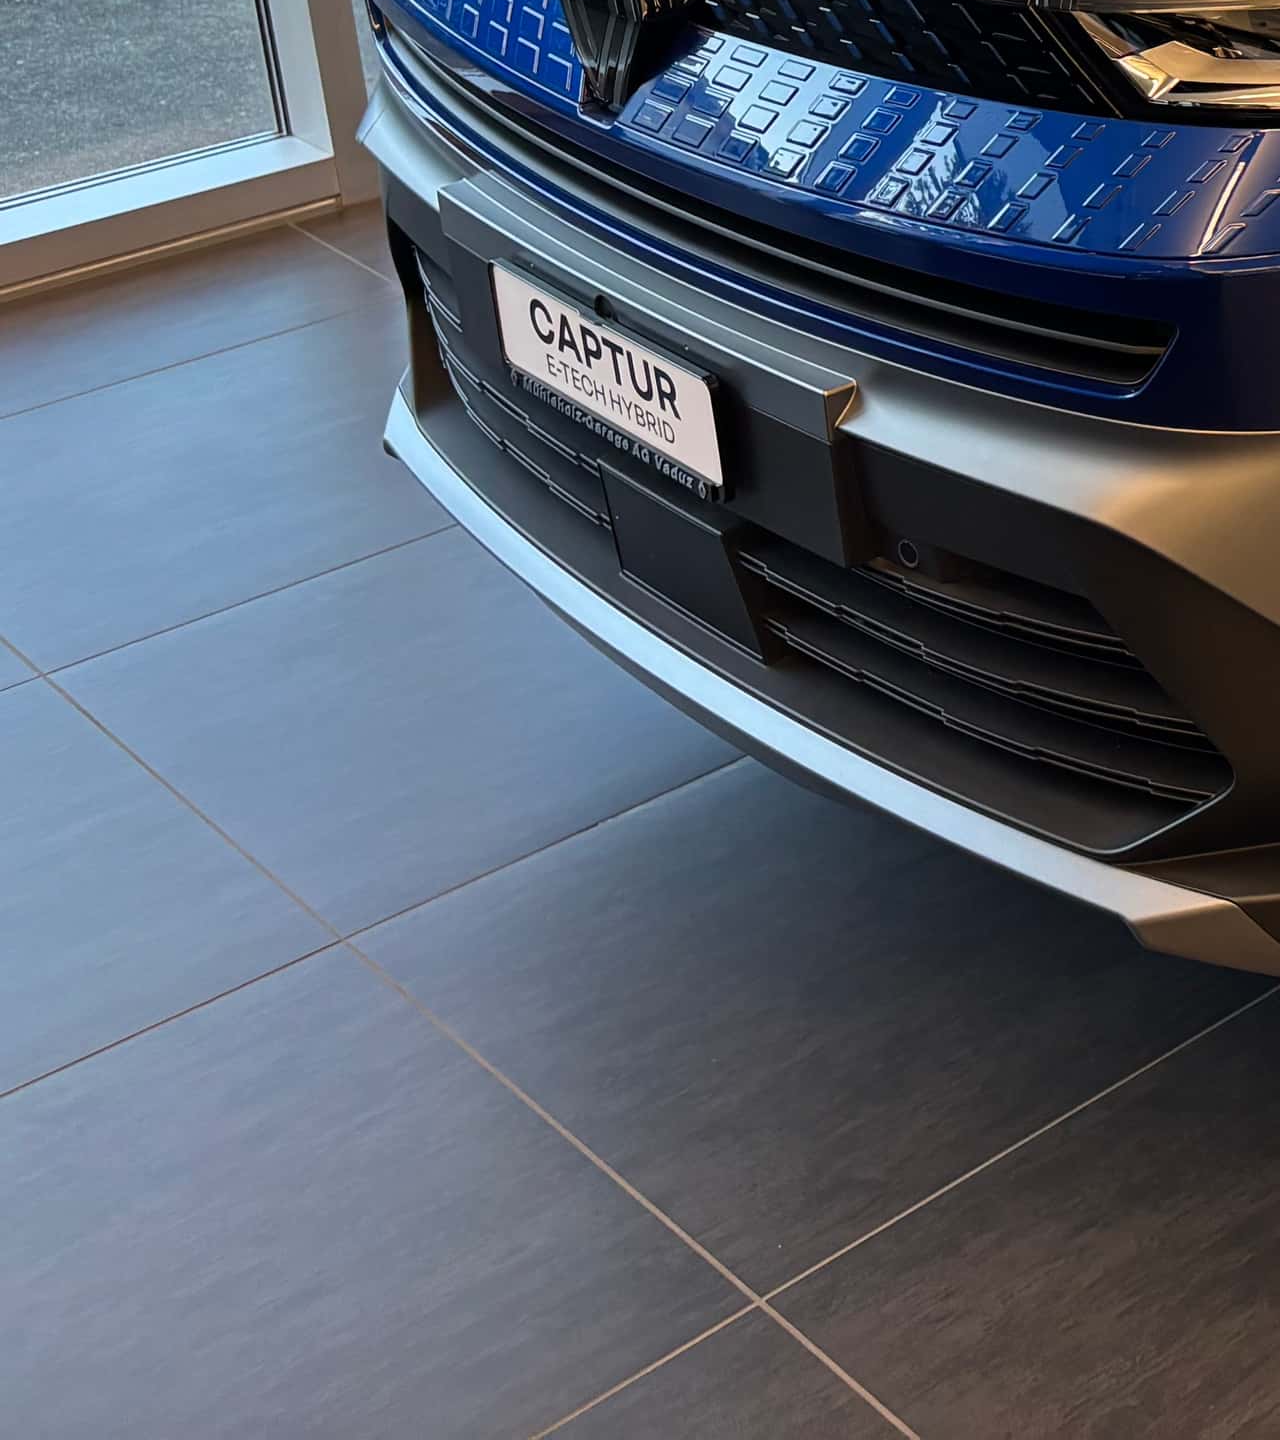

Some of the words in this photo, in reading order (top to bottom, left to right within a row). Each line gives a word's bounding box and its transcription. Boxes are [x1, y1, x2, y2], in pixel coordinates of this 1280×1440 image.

[529, 298, 682, 421] CAPTUR
[546, 353, 607, 406] E-TECH
[610, 388, 676, 444] HYBRID
[632, 442, 650, 465] AG
[655, 454, 694, 489] Vaduz
